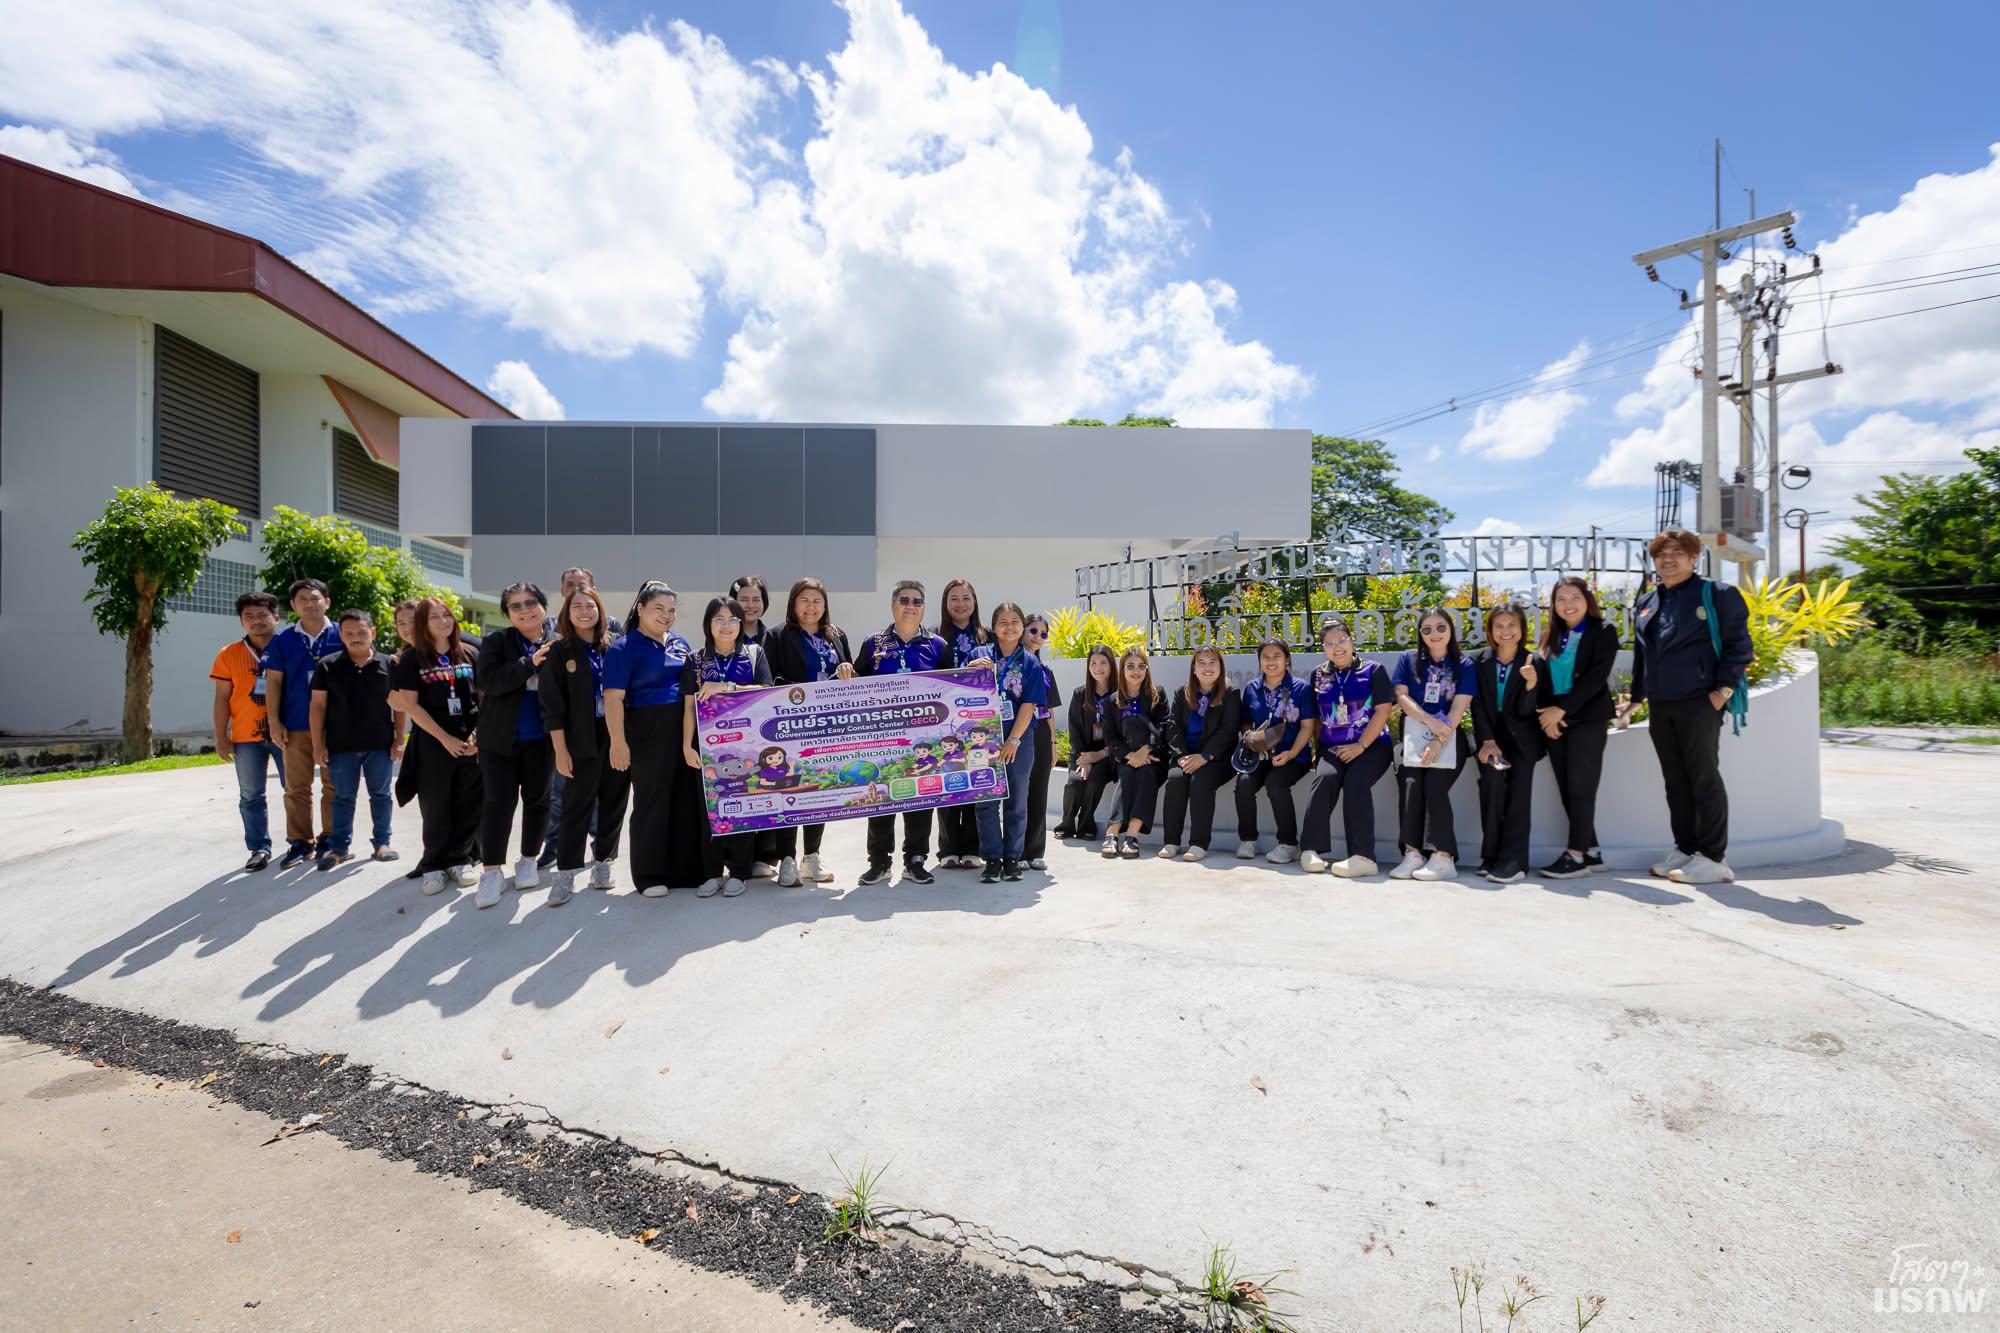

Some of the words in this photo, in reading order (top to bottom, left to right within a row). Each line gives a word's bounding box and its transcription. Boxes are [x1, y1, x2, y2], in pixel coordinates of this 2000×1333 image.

[815, 679, 910, 694] มหาวิทยาลัยราชภัฏสุรินทร์
[815, 692, 836, 700] SURIN
[837, 689, 871, 698] RAJABHAT
[873, 686, 910, 694] UNIVERSITY
[773, 692, 942, 715] โครงการเสริมสร้างศักยภาพ
[777, 704, 936, 733] ศูนย์ราชการสะดวก
[775, 730, 826, 741] (Government
[827, 726, 845, 736] Easy
[847, 723, 881, 733] Contact
[883, 720, 905, 729] Center
[911, 716, 940, 726] GECC)
[800, 729, 907, 747] มหาวิทยาลัยราชภัฏสุรินทร์
[811, 748, 905, 765] ลดปัญหาสิ่งแวดล้อม
[747, 802, 753, 810] 1
[766, 800, 773, 808] 3
